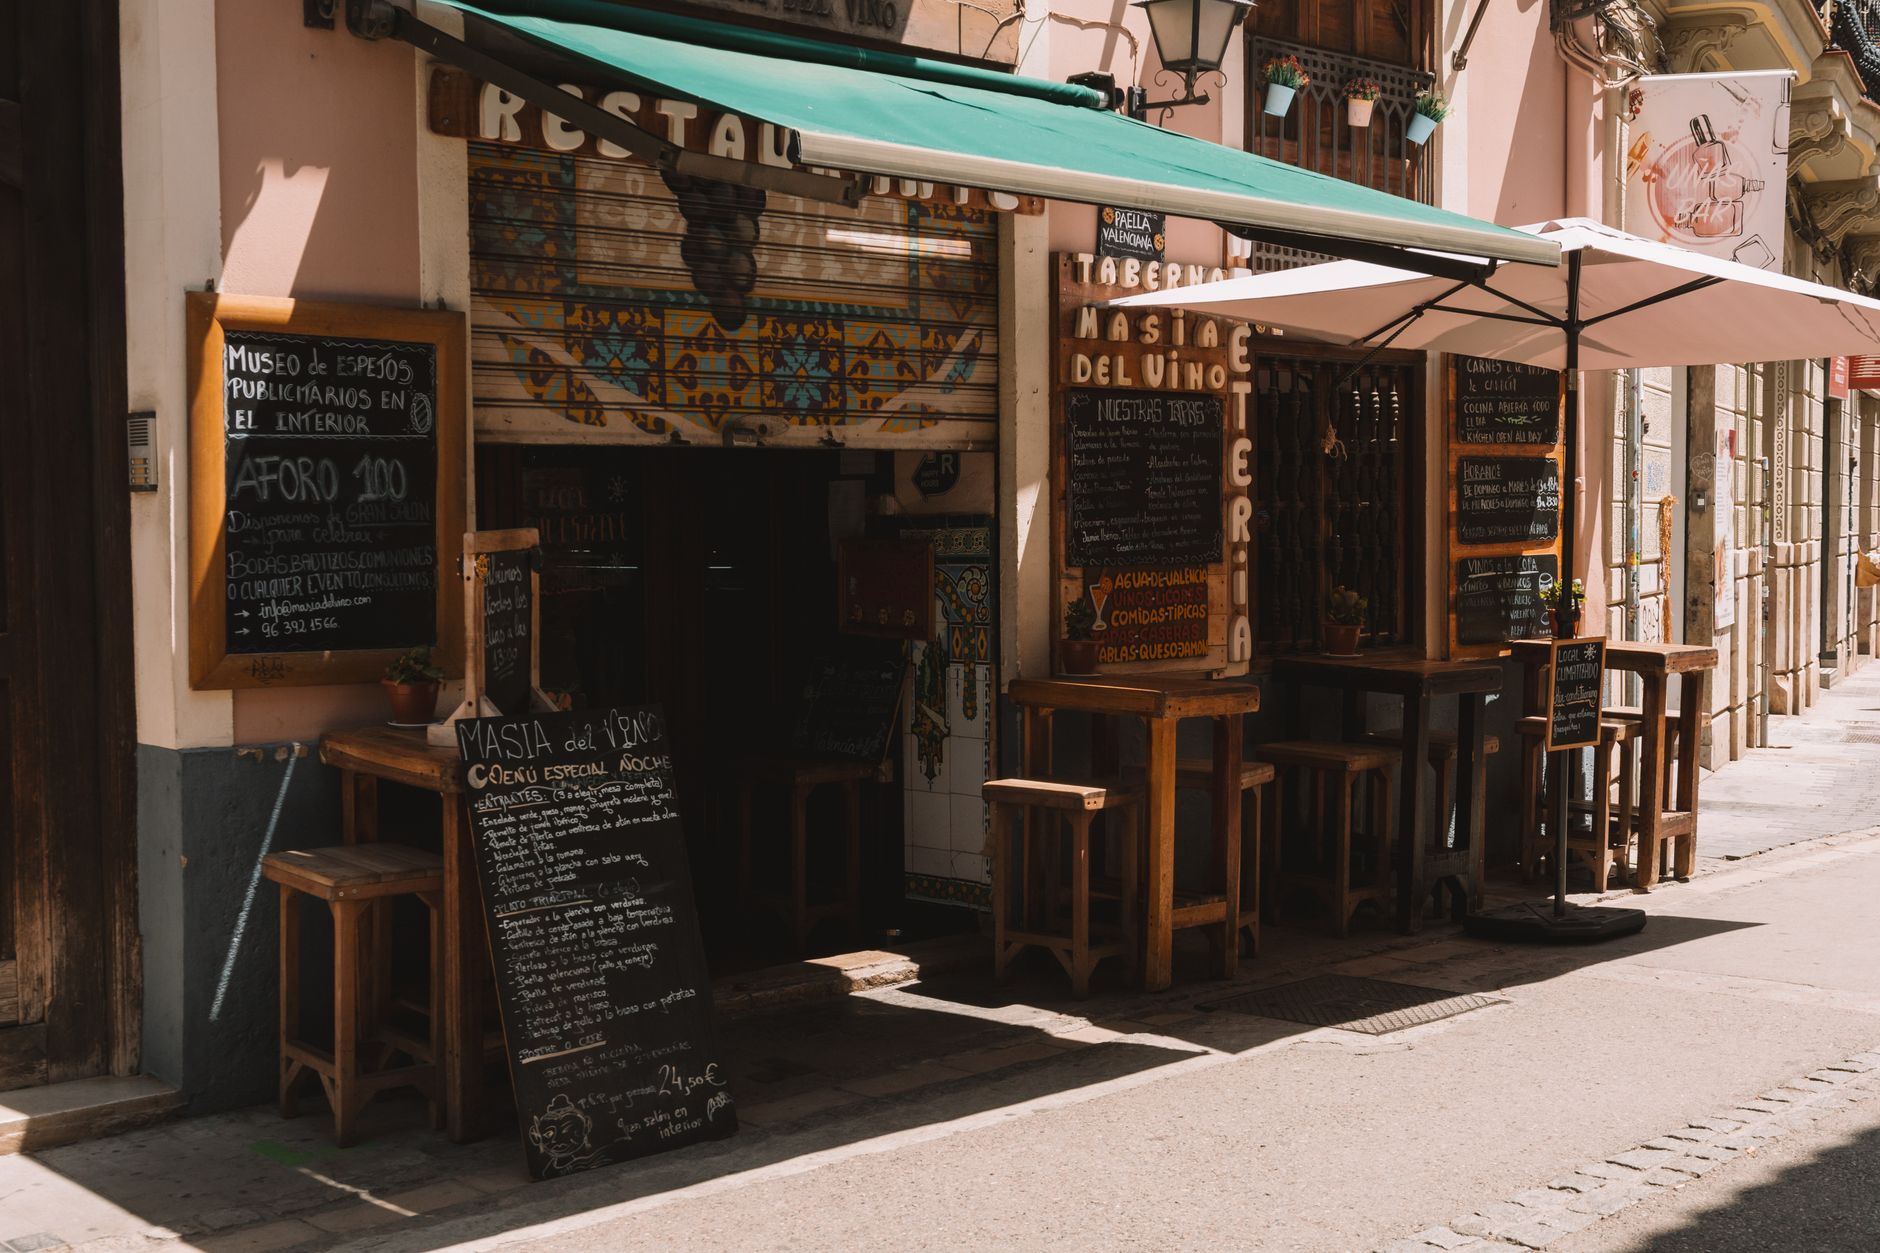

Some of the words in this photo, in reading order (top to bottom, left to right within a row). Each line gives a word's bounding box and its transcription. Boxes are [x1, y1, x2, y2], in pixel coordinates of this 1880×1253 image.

[1114, 210, 1152, 233] PAELLA
[1674, 198, 1736, 225] BAR
[1102, 227, 1155, 251] VALENCIANA
[1072, 253, 1225, 290] TABERNA
[228, 344, 301, 377] MUSEO
[307, 347, 328, 376] de
[336, 352, 414, 385] ESPEJOS
[1071, 353, 1132, 386] DEL
[228, 378, 372, 410] PUBLICITARIOS
[380, 390, 405, 410] EN
[1097, 398, 1163, 423] NUESTRAS
[1166, 399, 1205, 428] TAPAS
[1463, 402, 1494, 414] COCINA
[1498, 400, 1529, 415] ABIERTA
[235, 409, 259, 430] EL
[274, 408, 370, 434] INTERIOR
[1496, 430, 1512, 443] OPEN
[1515, 430, 1526, 443] ALL
[1528, 430, 1543, 443] DAY
[231, 455, 339, 502] AFORO
[352, 452, 408, 503] 100
[227, 509, 320, 534] Disponemos
[326, 504, 343, 525] de
[312, 521, 373, 544] celebrar
[240, 574, 304, 600] CUALQUIER
[514, 584, 529, 610] los
[261, 622, 280, 638] 96
[283, 619, 308, 635] 392
[309, 617, 338, 632] 1566
[1558, 648, 1580, 663] LOCAL
[459, 719, 553, 761] MASIA
[564, 723, 597, 752] del
[543, 761, 609, 781] ESPECIAL
[657, 1062, 728, 1098] 24,50€
[674, 1106, 688, 1116] en
